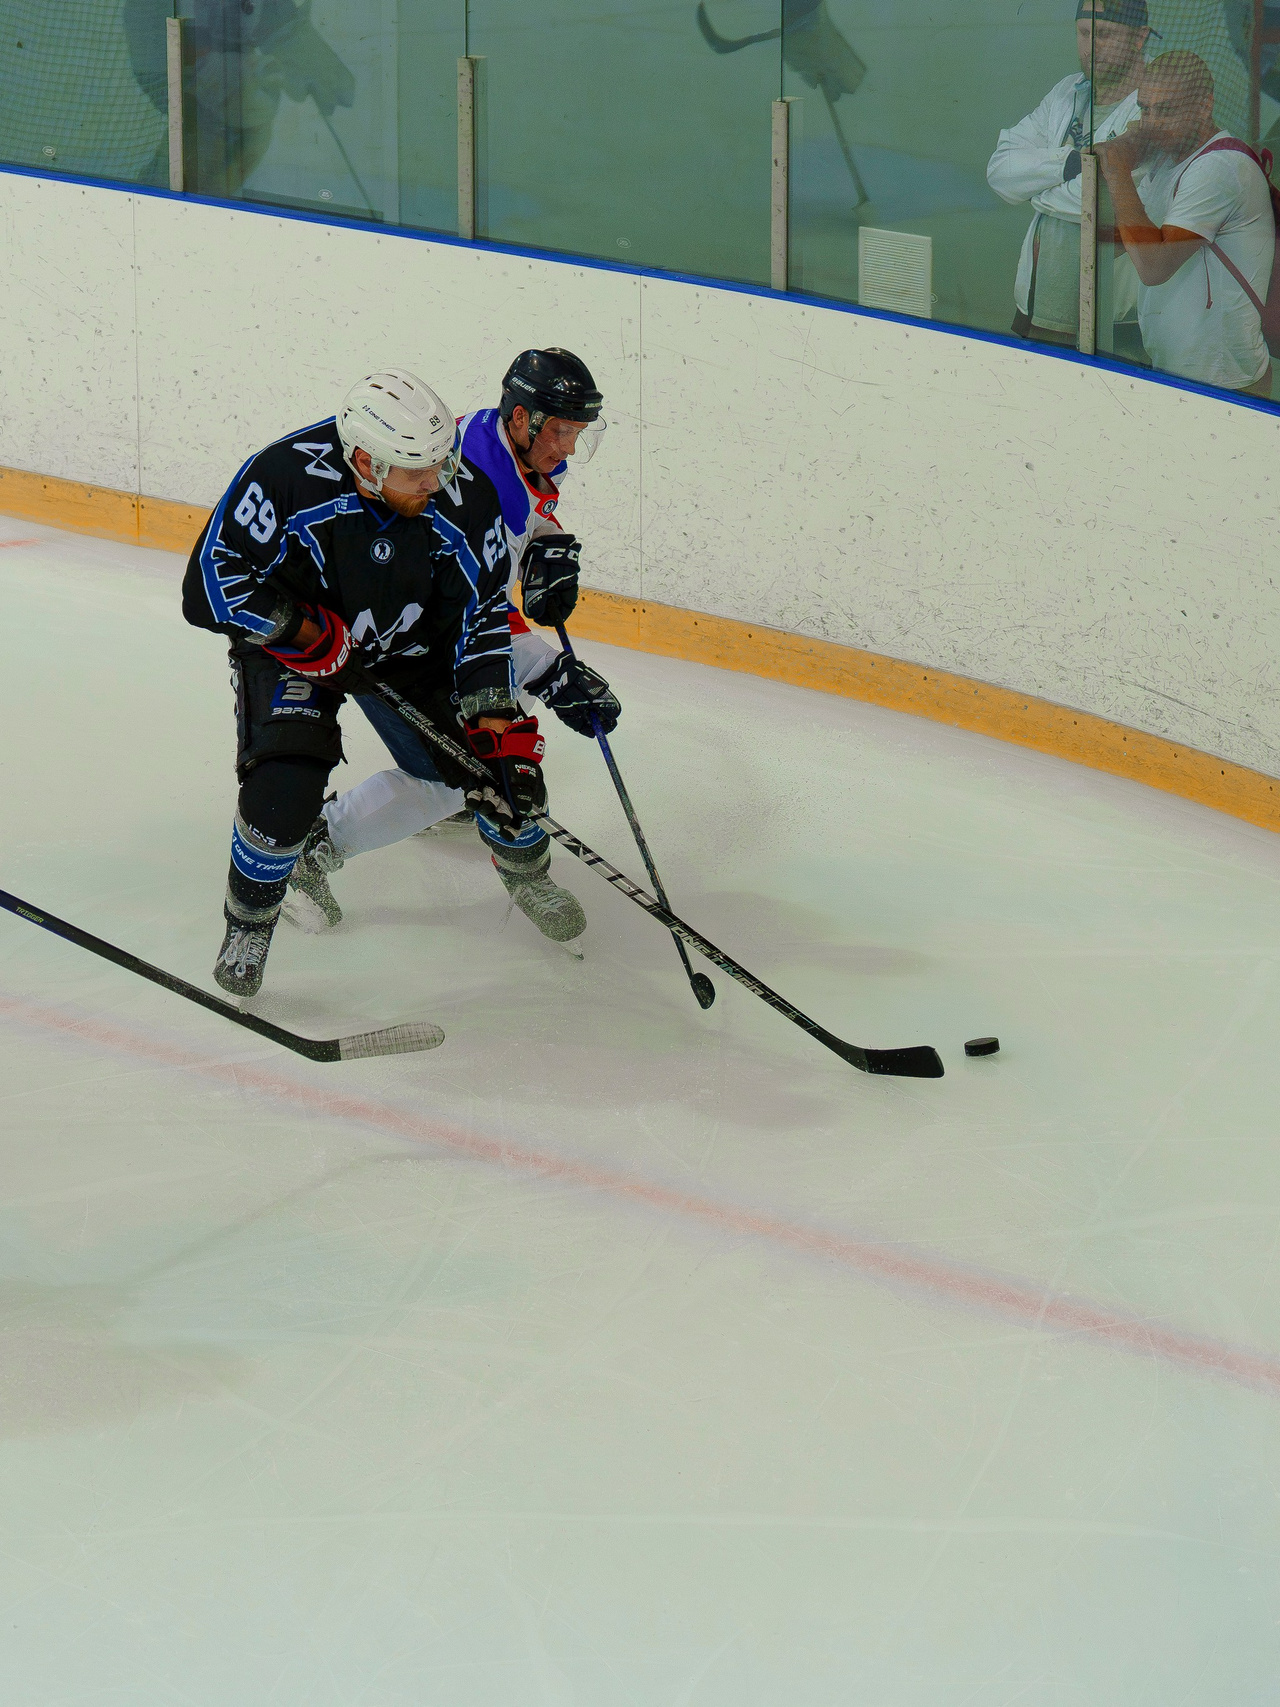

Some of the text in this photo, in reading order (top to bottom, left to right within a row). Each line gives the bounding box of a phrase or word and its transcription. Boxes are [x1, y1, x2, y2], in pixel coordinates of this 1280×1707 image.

[234, 481, 277, 544] 69
[544, 548, 580, 562] CC
[538, 671, 569, 703] CM
[234, 844, 255, 865] ONE
[15, 906, 44, 923] TRIGGER
[671, 926, 765, 996] ONE TIMER
